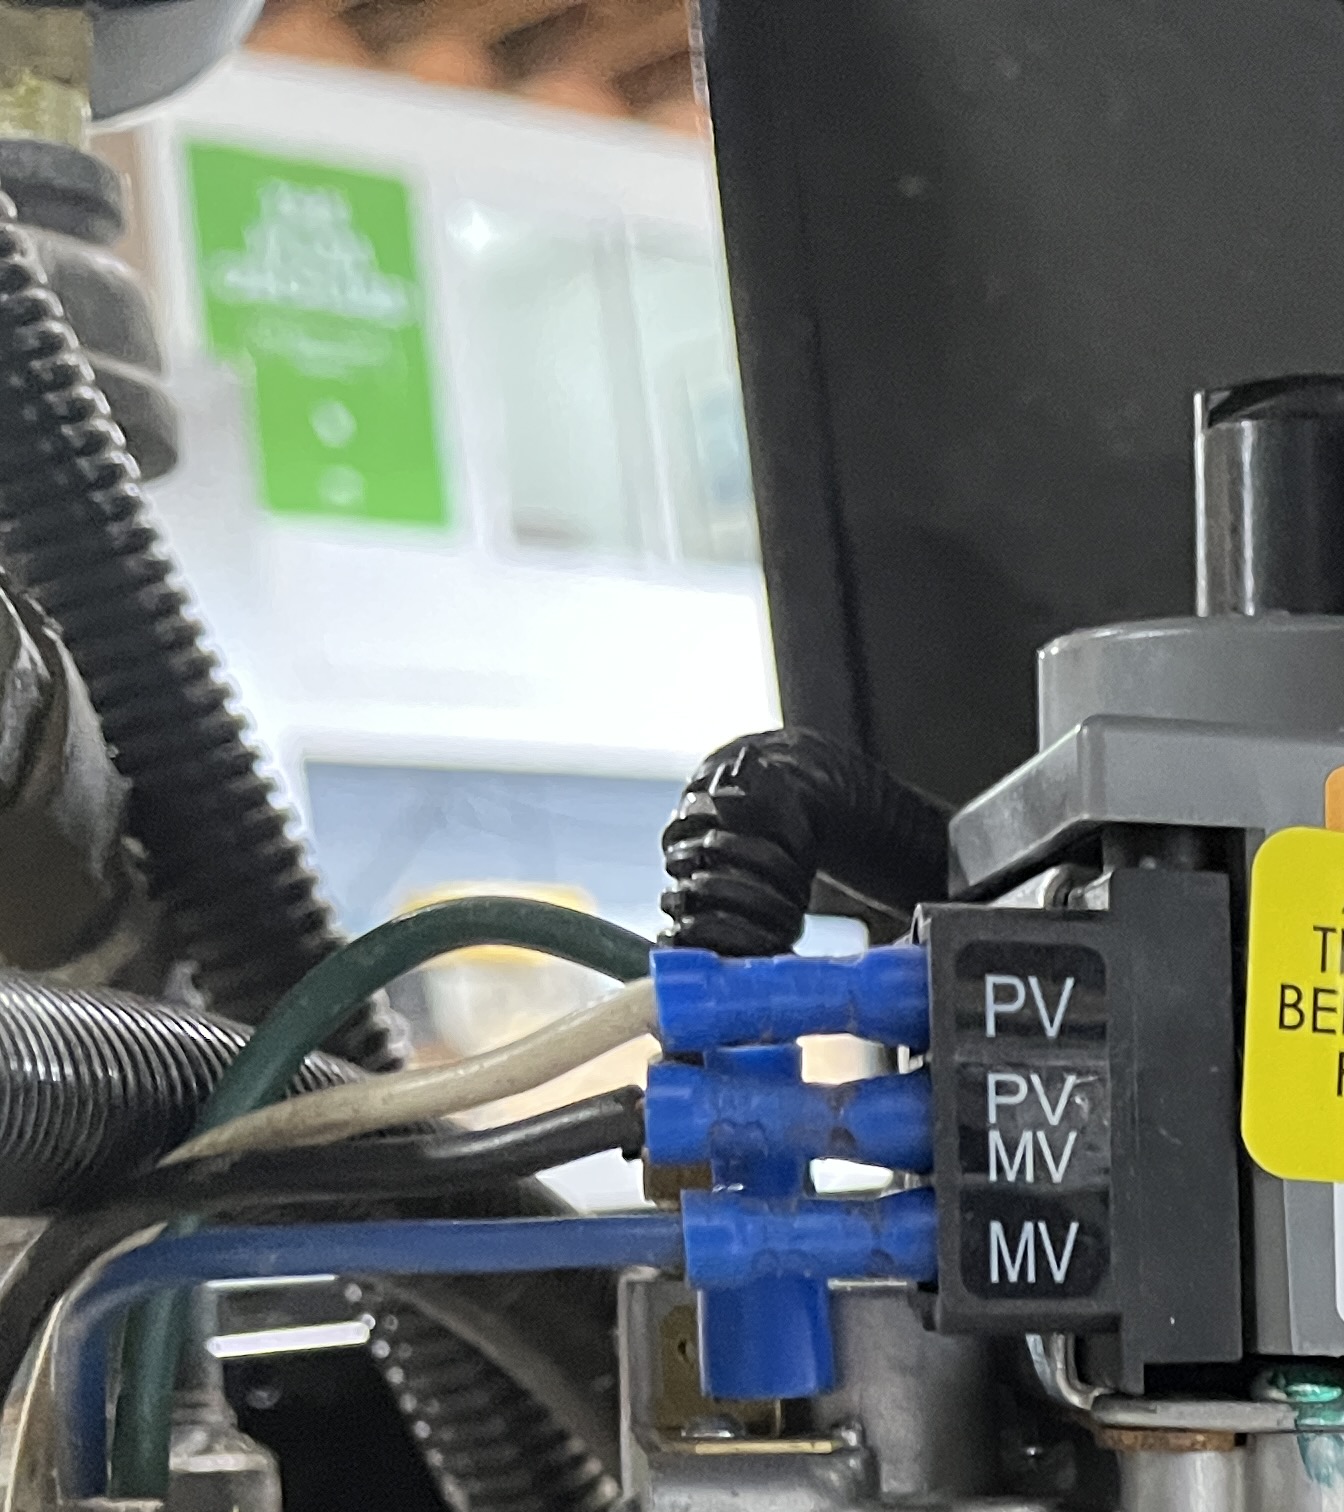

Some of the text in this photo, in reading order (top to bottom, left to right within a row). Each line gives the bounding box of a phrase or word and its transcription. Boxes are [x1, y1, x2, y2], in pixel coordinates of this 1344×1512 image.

[984, 973, 1076, 1039] PV
[985, 1074, 1077, 1128] PV
[987, 1129, 1078, 1185] MV
[988, 1220, 1080, 1285] MV
